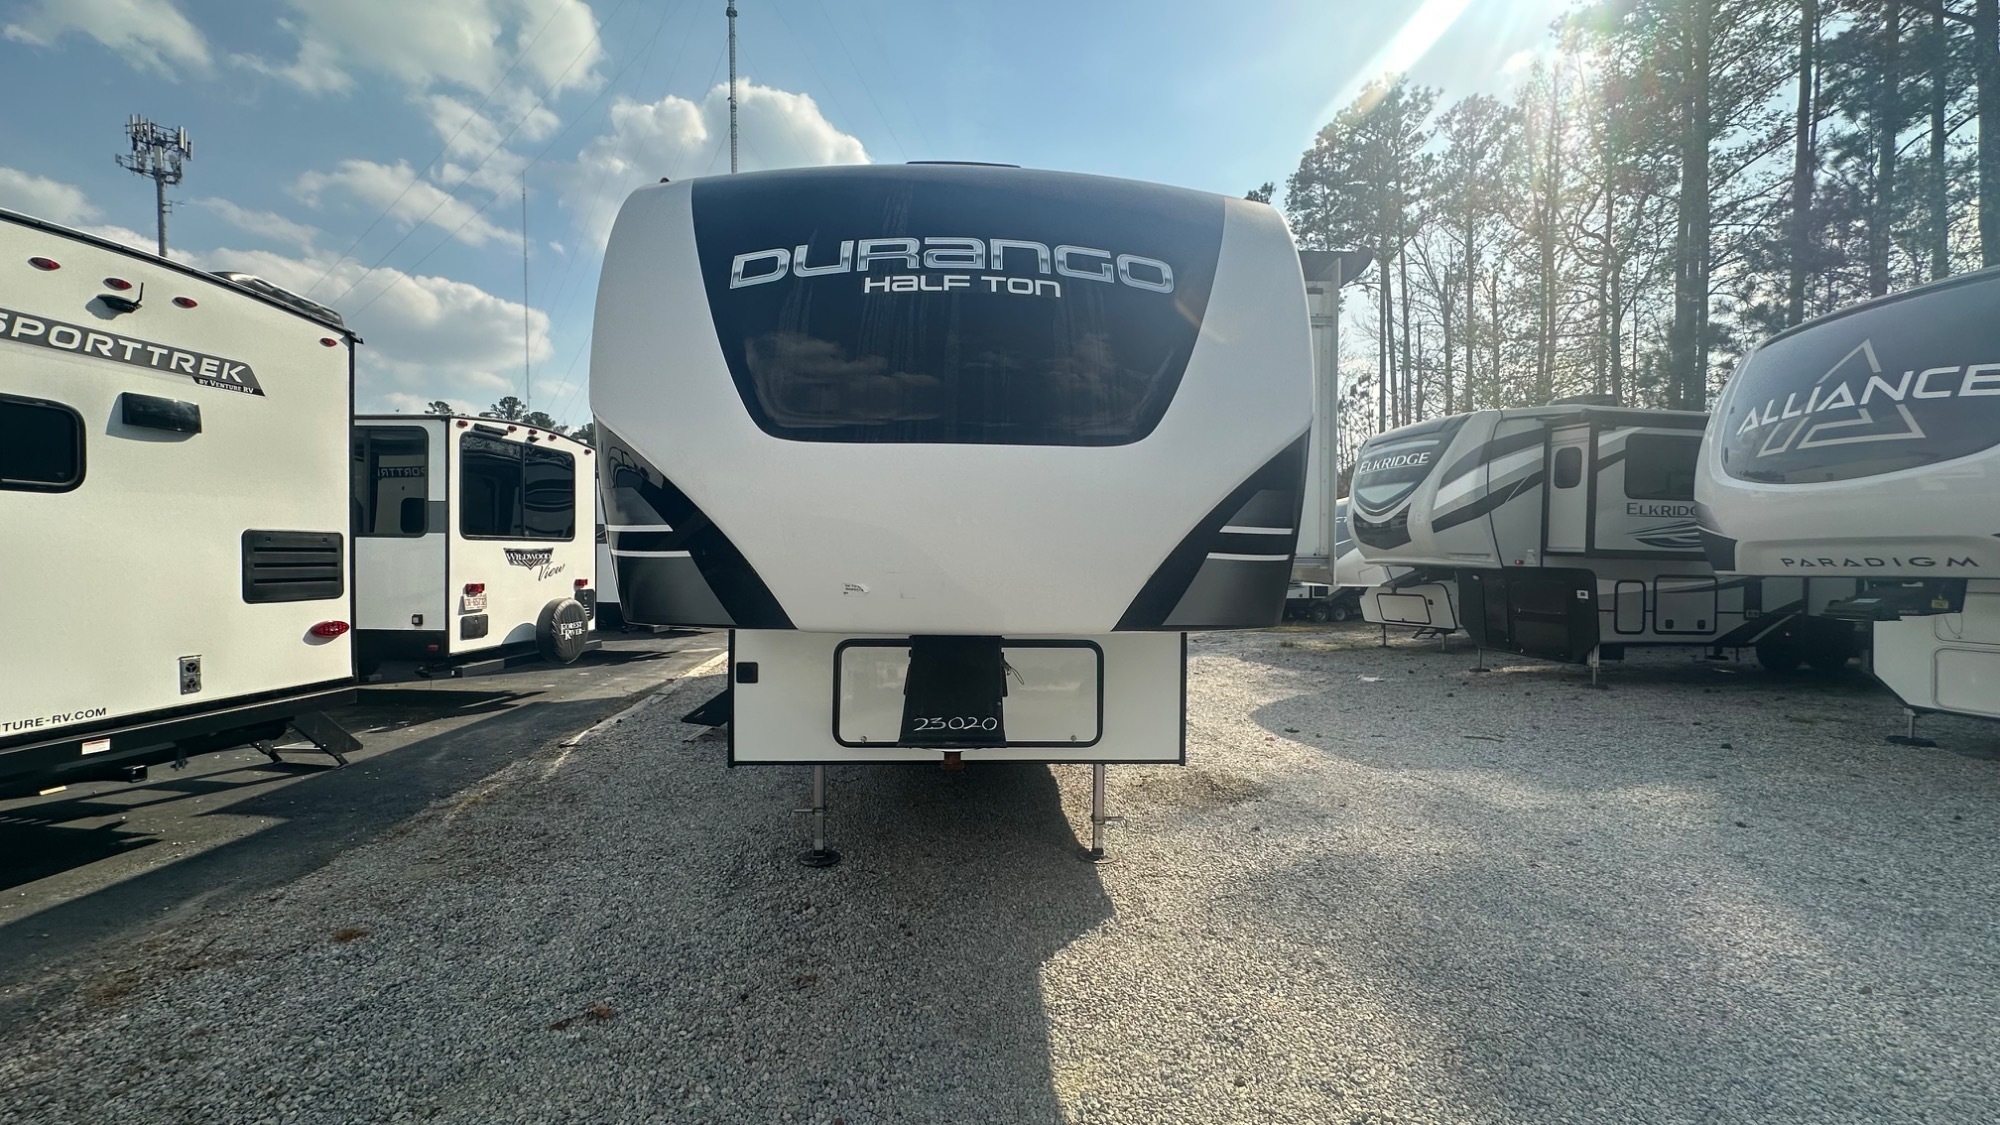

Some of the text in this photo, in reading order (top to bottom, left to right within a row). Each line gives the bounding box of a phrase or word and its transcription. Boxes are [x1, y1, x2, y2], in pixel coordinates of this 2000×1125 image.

[730, 237, 1174, 294] DURANGO
[864, 275, 1061, 298] HALF TON
[0, 313, 246, 383] PORTTREK
[210, 380, 242, 392] VENTURE
[243, 386, 254, 394] RV
[1737, 363, 2000, 436] ALLIANCE
[1359, 452, 1431, 474] ELKRIDGE
[506, 552, 551, 561] WILDWOOD
[1780, 557, 1979, 568] PARADIGM
[538, 561, 566, 581] View
[560, 621, 583, 636] FOREST
[565, 628, 586, 640] RIVER
[0, 707, 107, 732] TURE-RV.COM
[914, 716, 998, 731] 23020
